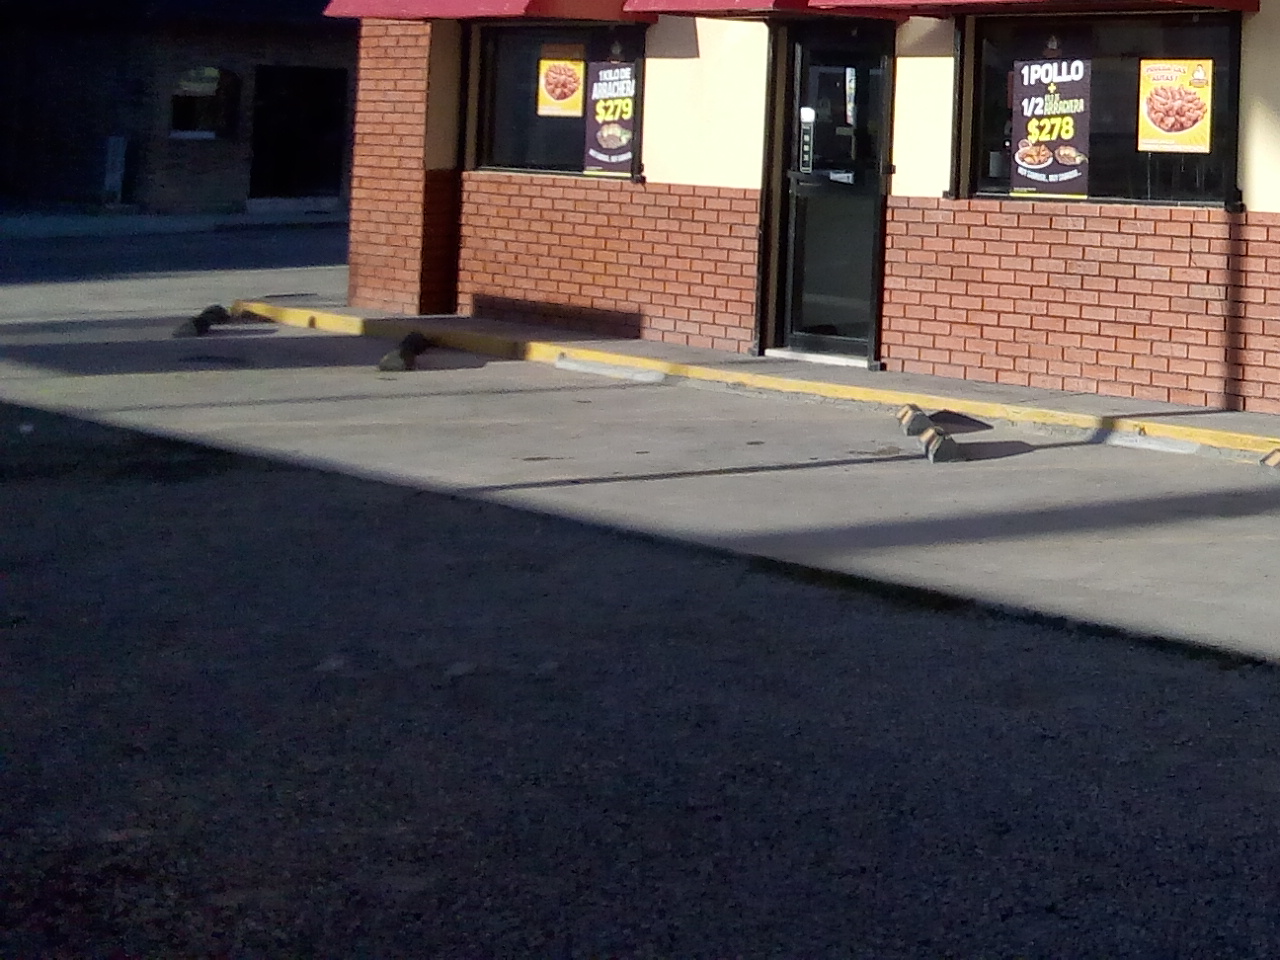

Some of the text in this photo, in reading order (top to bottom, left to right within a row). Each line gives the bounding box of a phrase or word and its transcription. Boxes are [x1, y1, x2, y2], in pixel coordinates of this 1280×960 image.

[595, 98, 633, 124] $279
[1021, 95, 1044, 118] 1/2
[1027, 115, 1075, 144] $278
